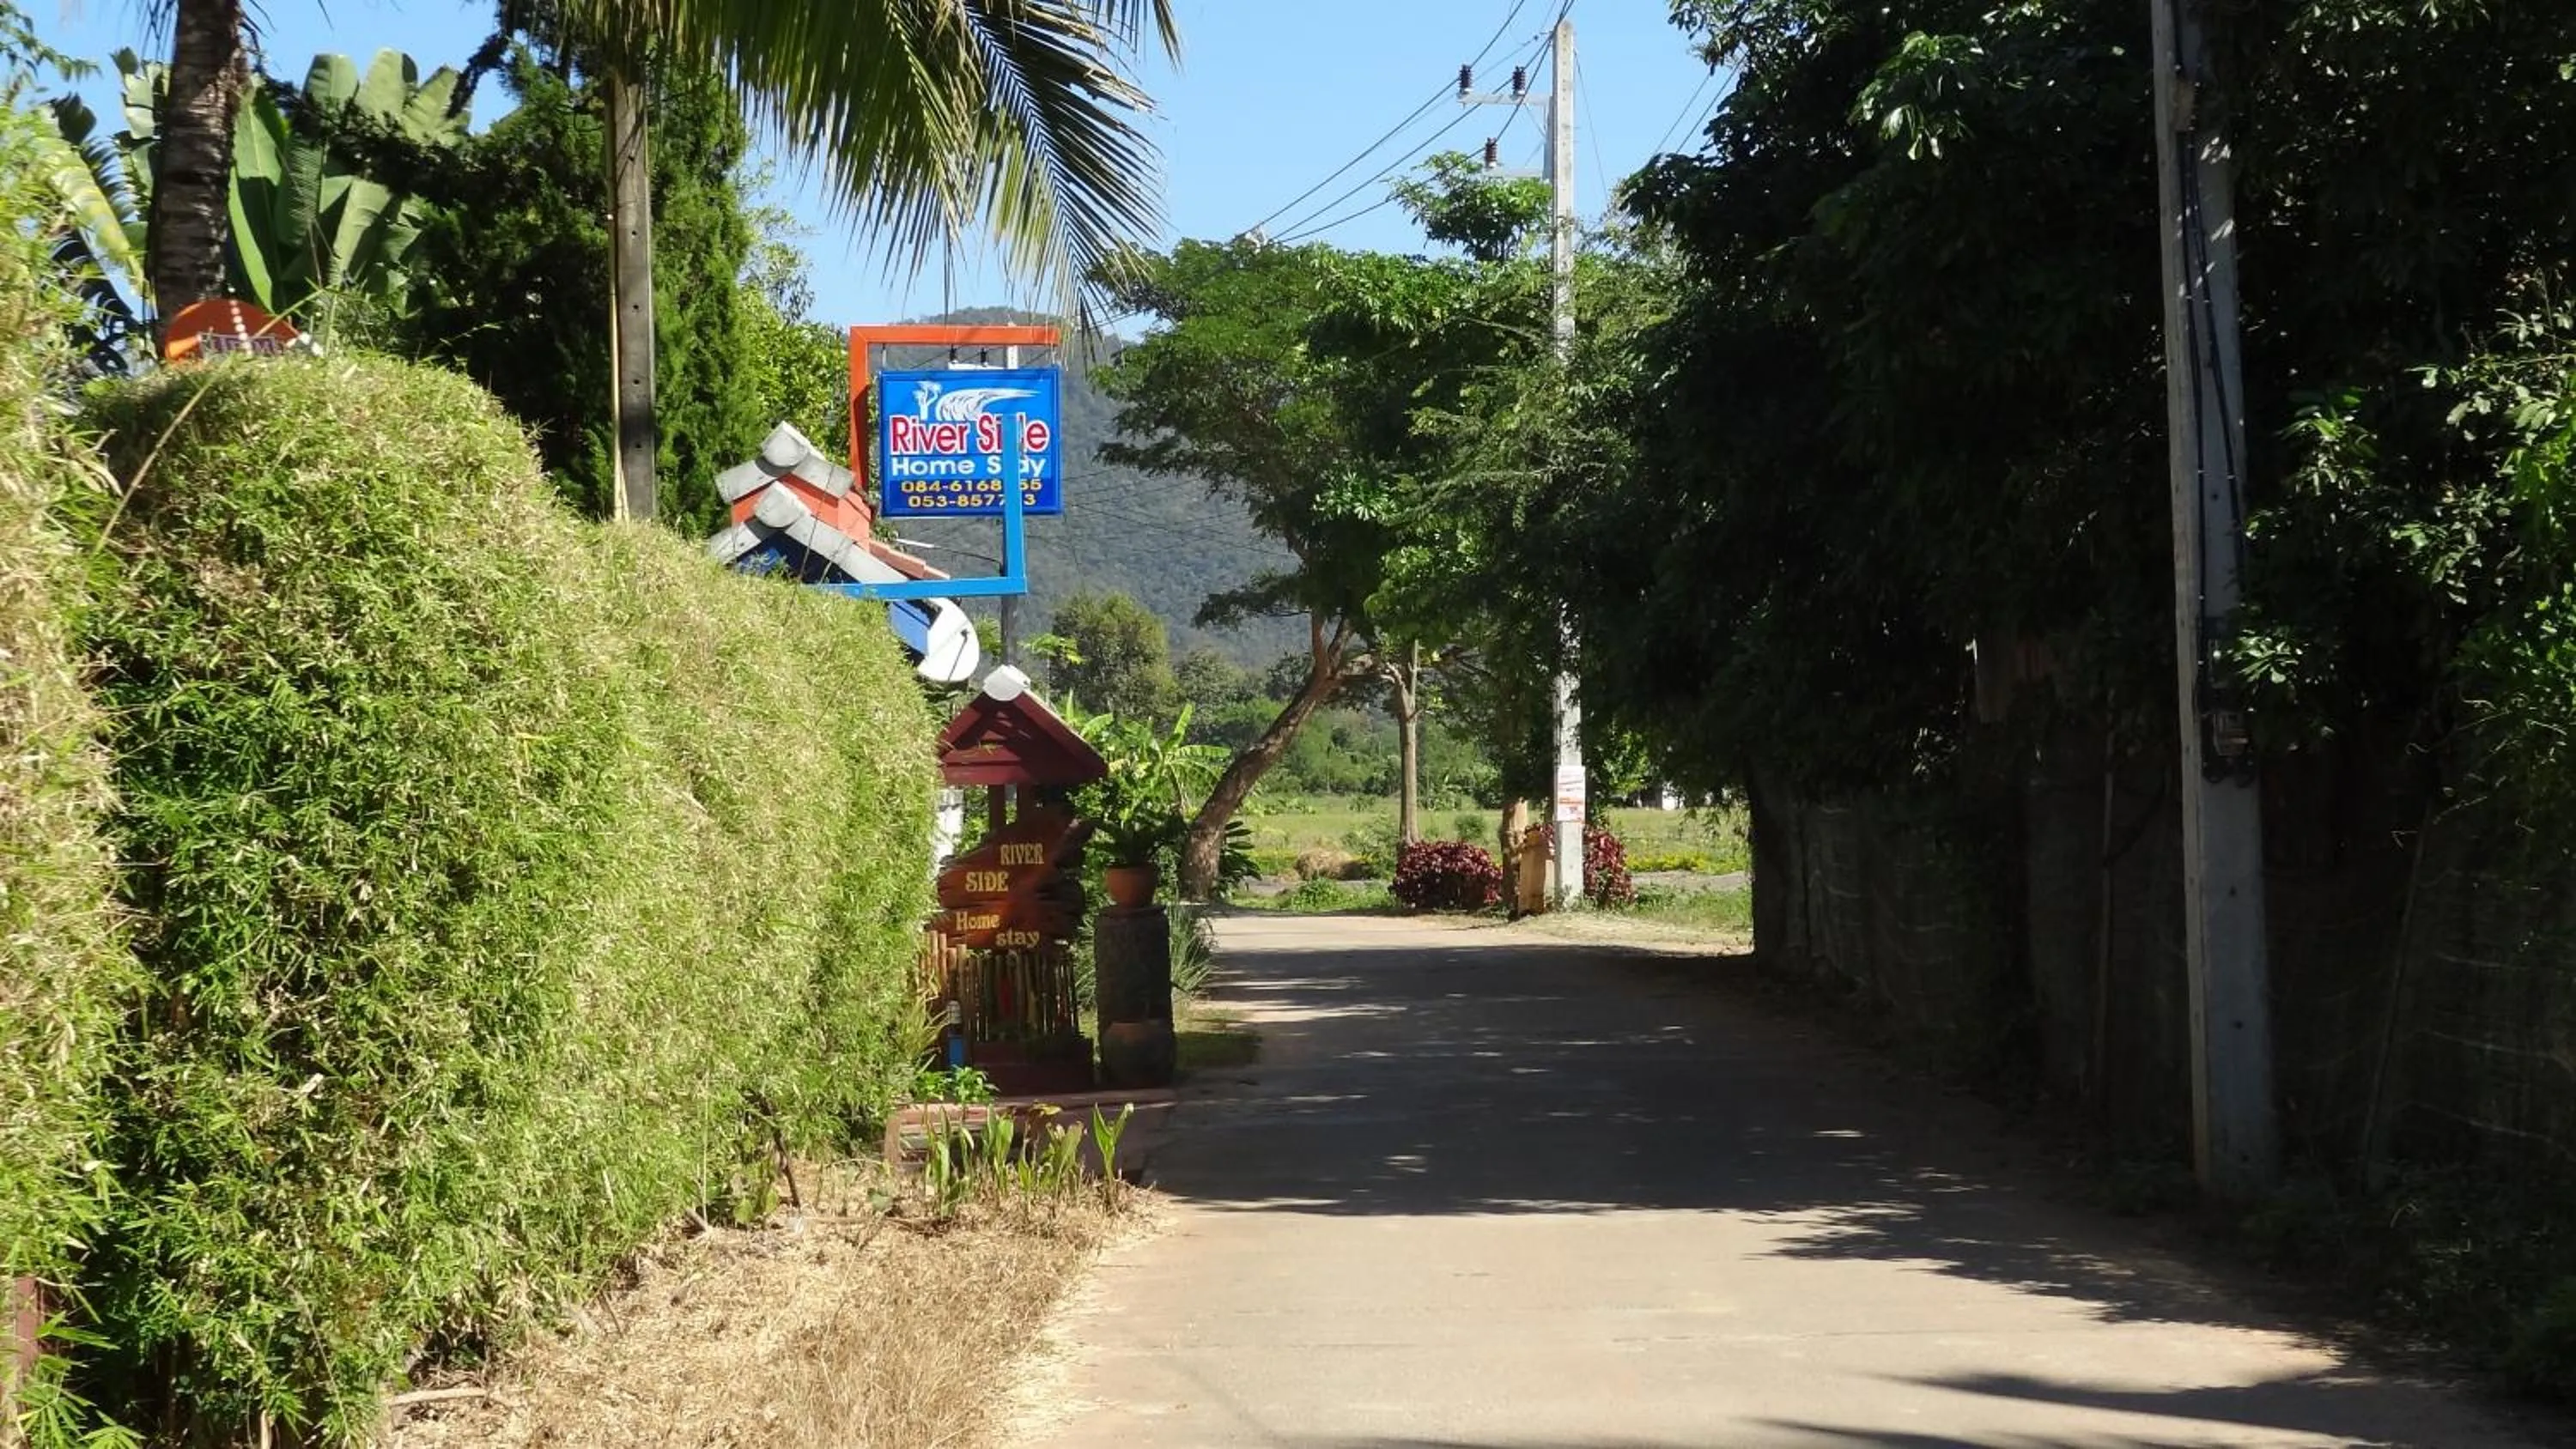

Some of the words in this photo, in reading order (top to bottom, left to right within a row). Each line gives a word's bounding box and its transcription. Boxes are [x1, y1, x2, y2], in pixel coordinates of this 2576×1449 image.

[890, 415, 969, 454] River
[891, 456, 975, 476] Home
[987, 455, 1046, 478] Say
[901, 479, 1042, 493] 084-616855
[908, 494, 1036, 507] 053-85773
[999, 843, 1044, 865] RIVER
[965, 871, 1009, 892] SIDE
[956, 912, 999, 931] Home
[995, 928, 1040, 948] stay
